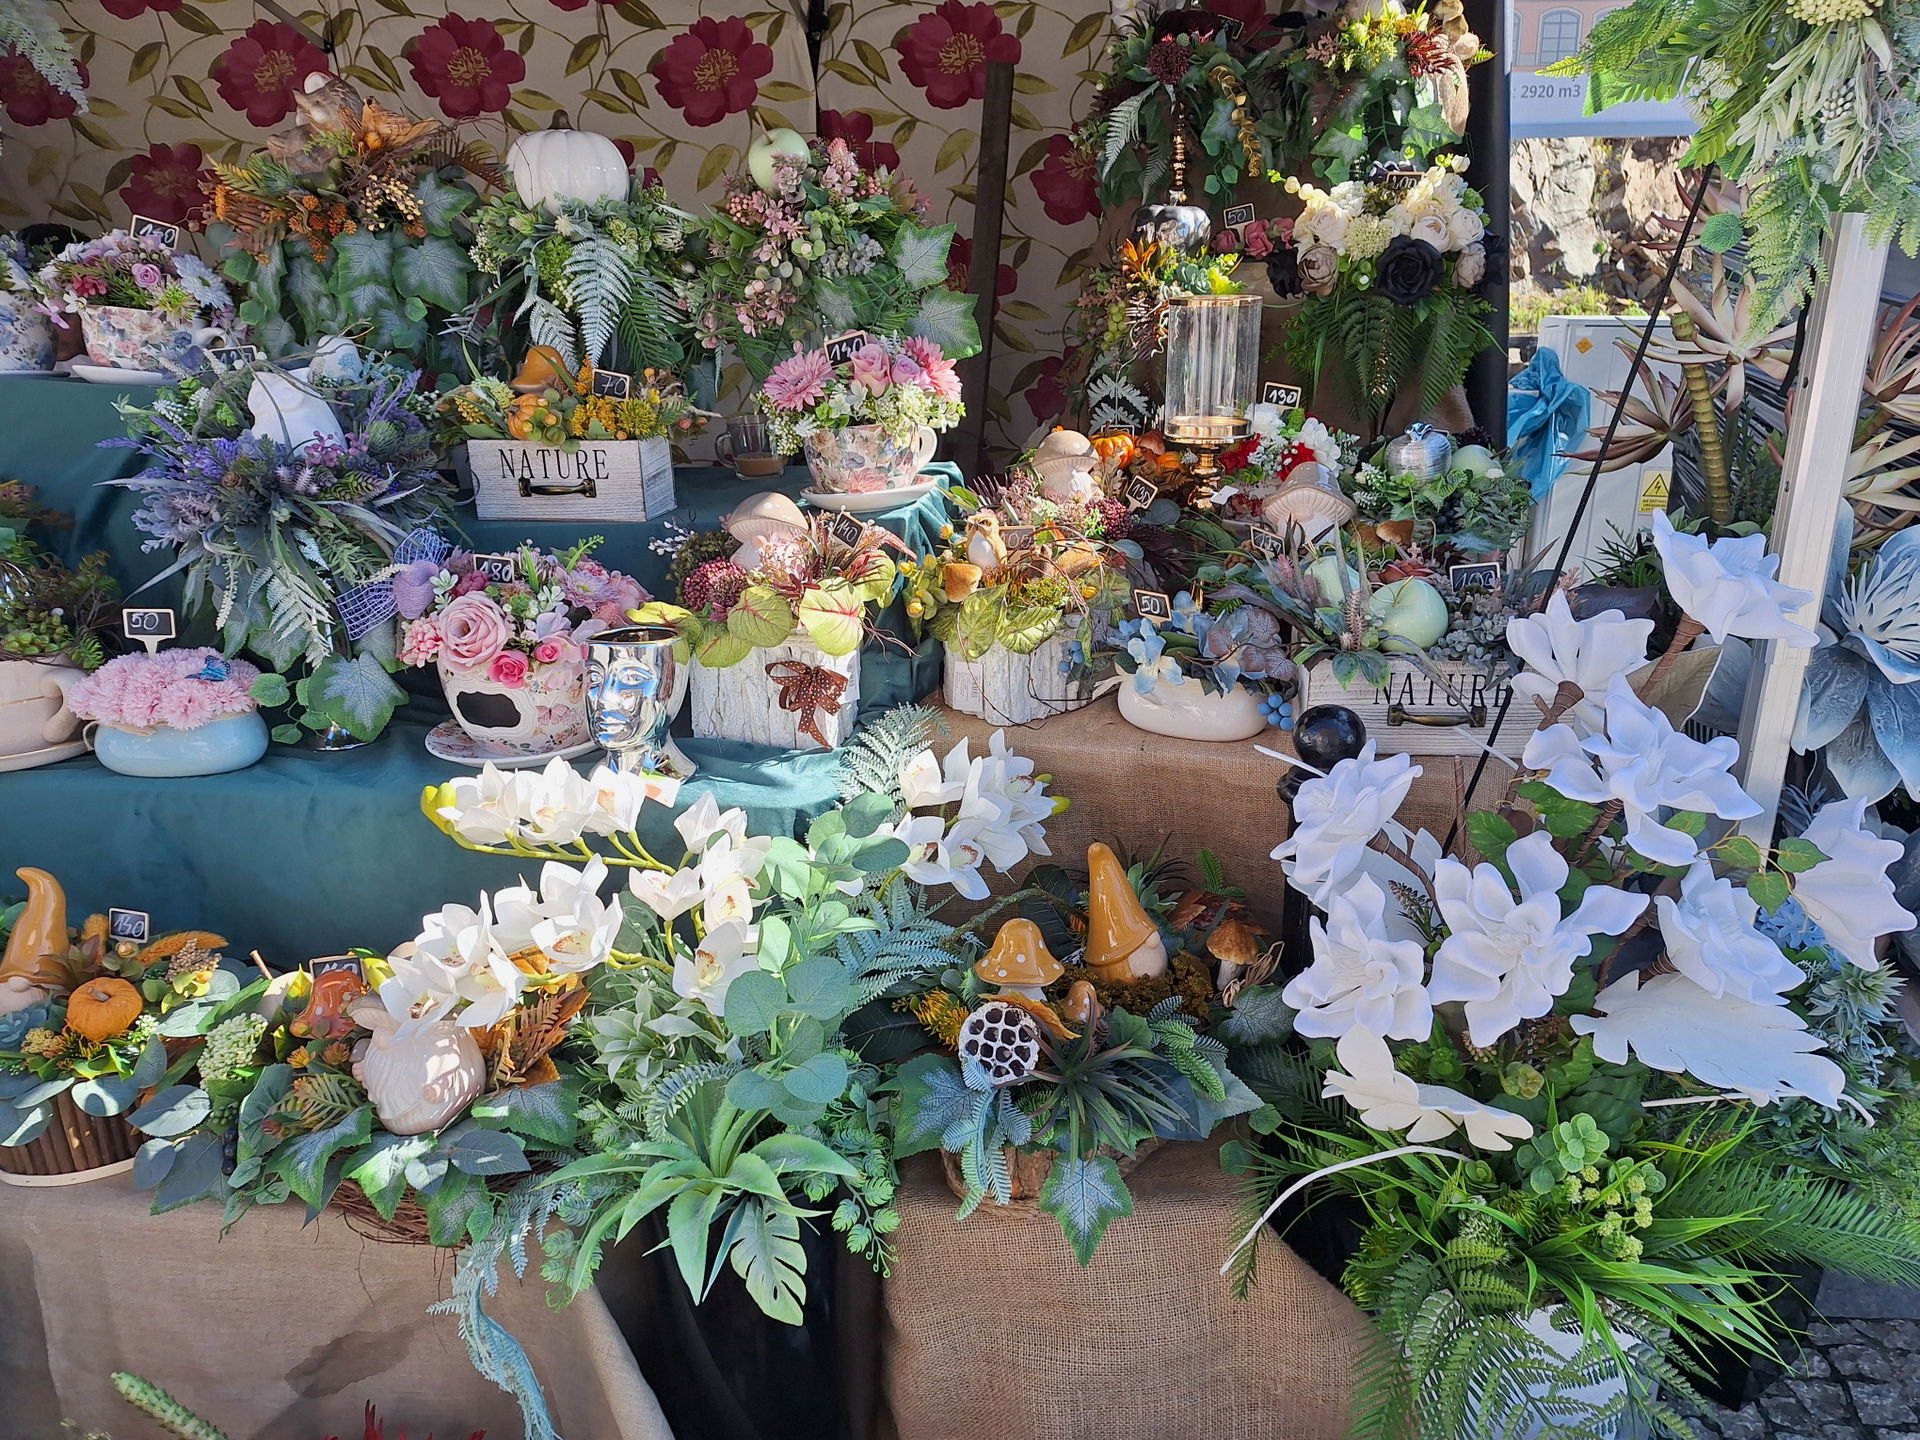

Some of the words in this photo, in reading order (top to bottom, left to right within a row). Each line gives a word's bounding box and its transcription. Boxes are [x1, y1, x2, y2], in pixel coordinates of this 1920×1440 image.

[1521, 84, 1554, 99] 2920
[1558, 84, 1581, 98] m3
[1228, 208, 1246, 224] 50
[601, 373, 628, 395] 70
[498, 448, 610, 480] NATURE
[836, 518, 858, 543] 140
[479, 560, 512, 582] 180
[1141, 595, 1160, 615] 50
[131, 612, 158, 630] 50
